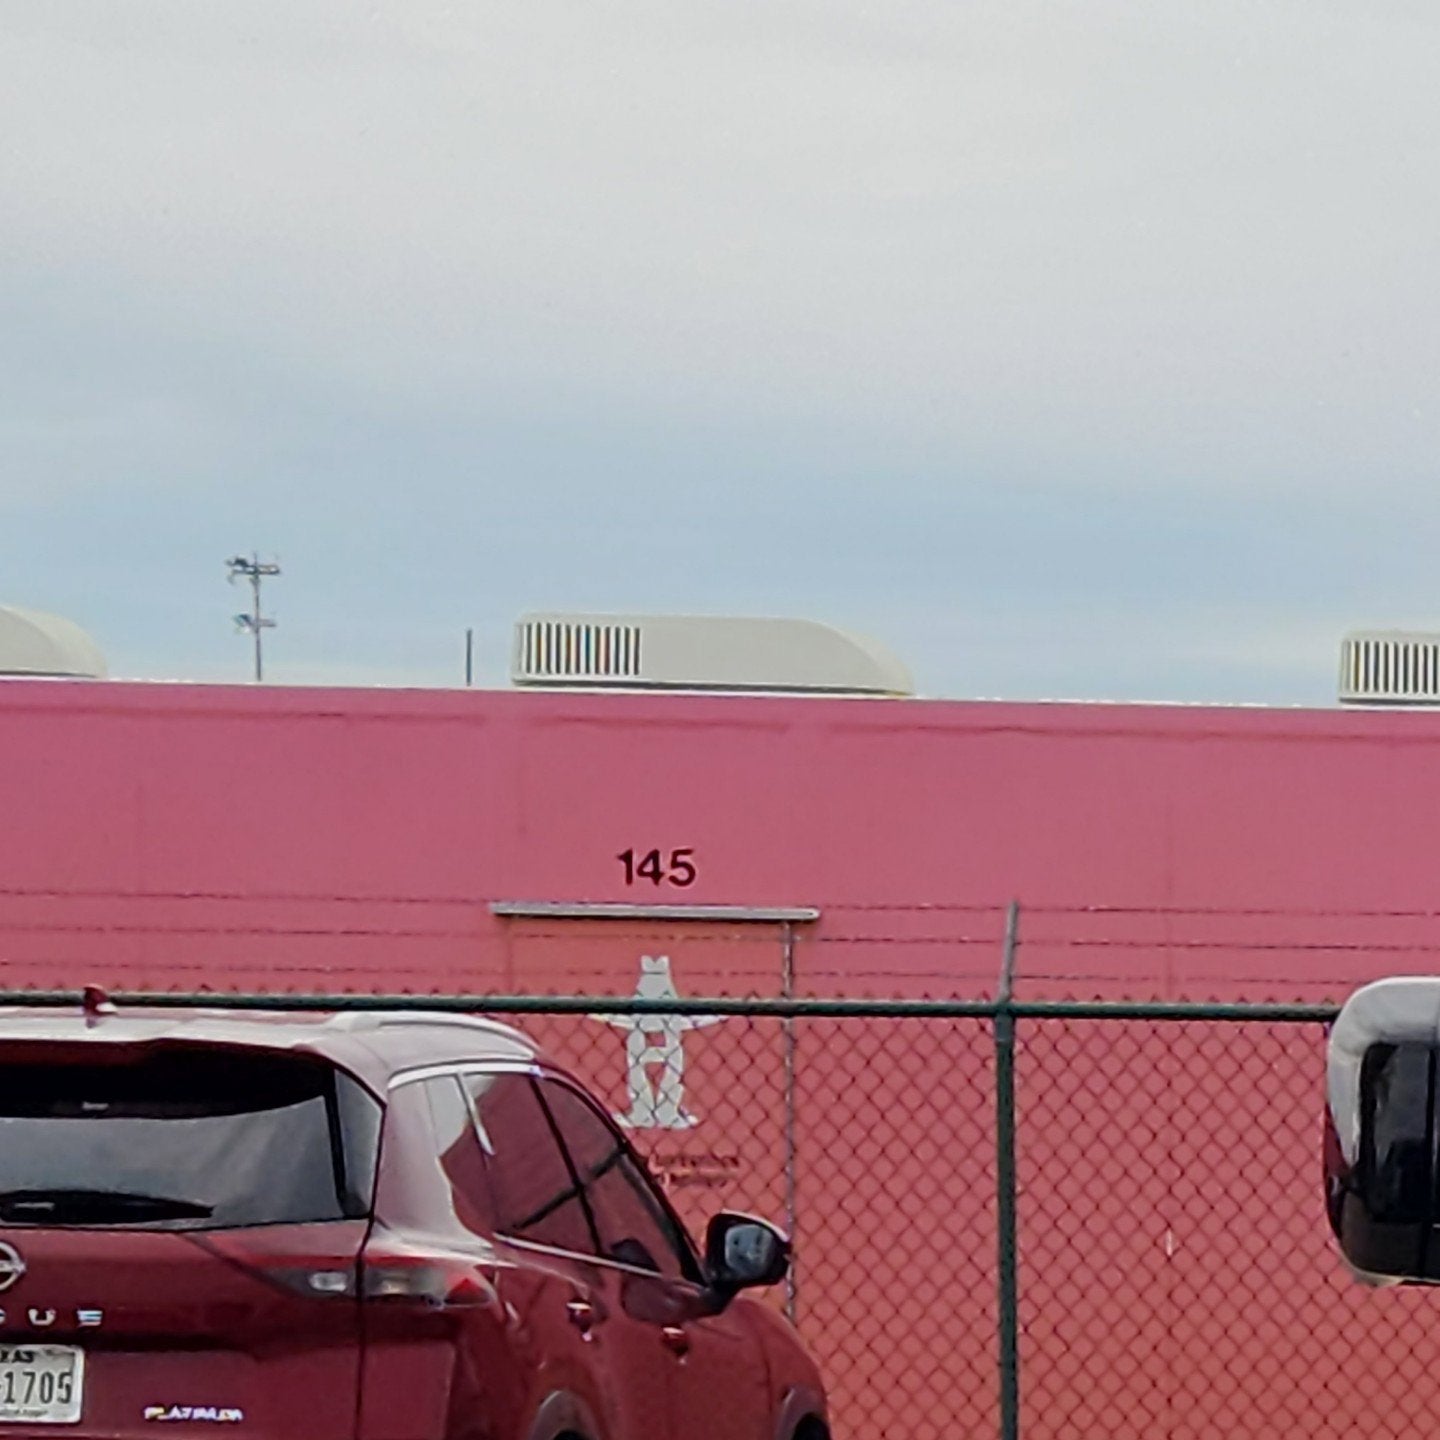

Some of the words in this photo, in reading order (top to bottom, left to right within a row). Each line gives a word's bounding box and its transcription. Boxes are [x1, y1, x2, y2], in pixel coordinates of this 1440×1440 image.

[616, 848, 696, 887] 145
[0, 1308, 103, 1327] UE
[4, 1371, 72, 1404] 1705
